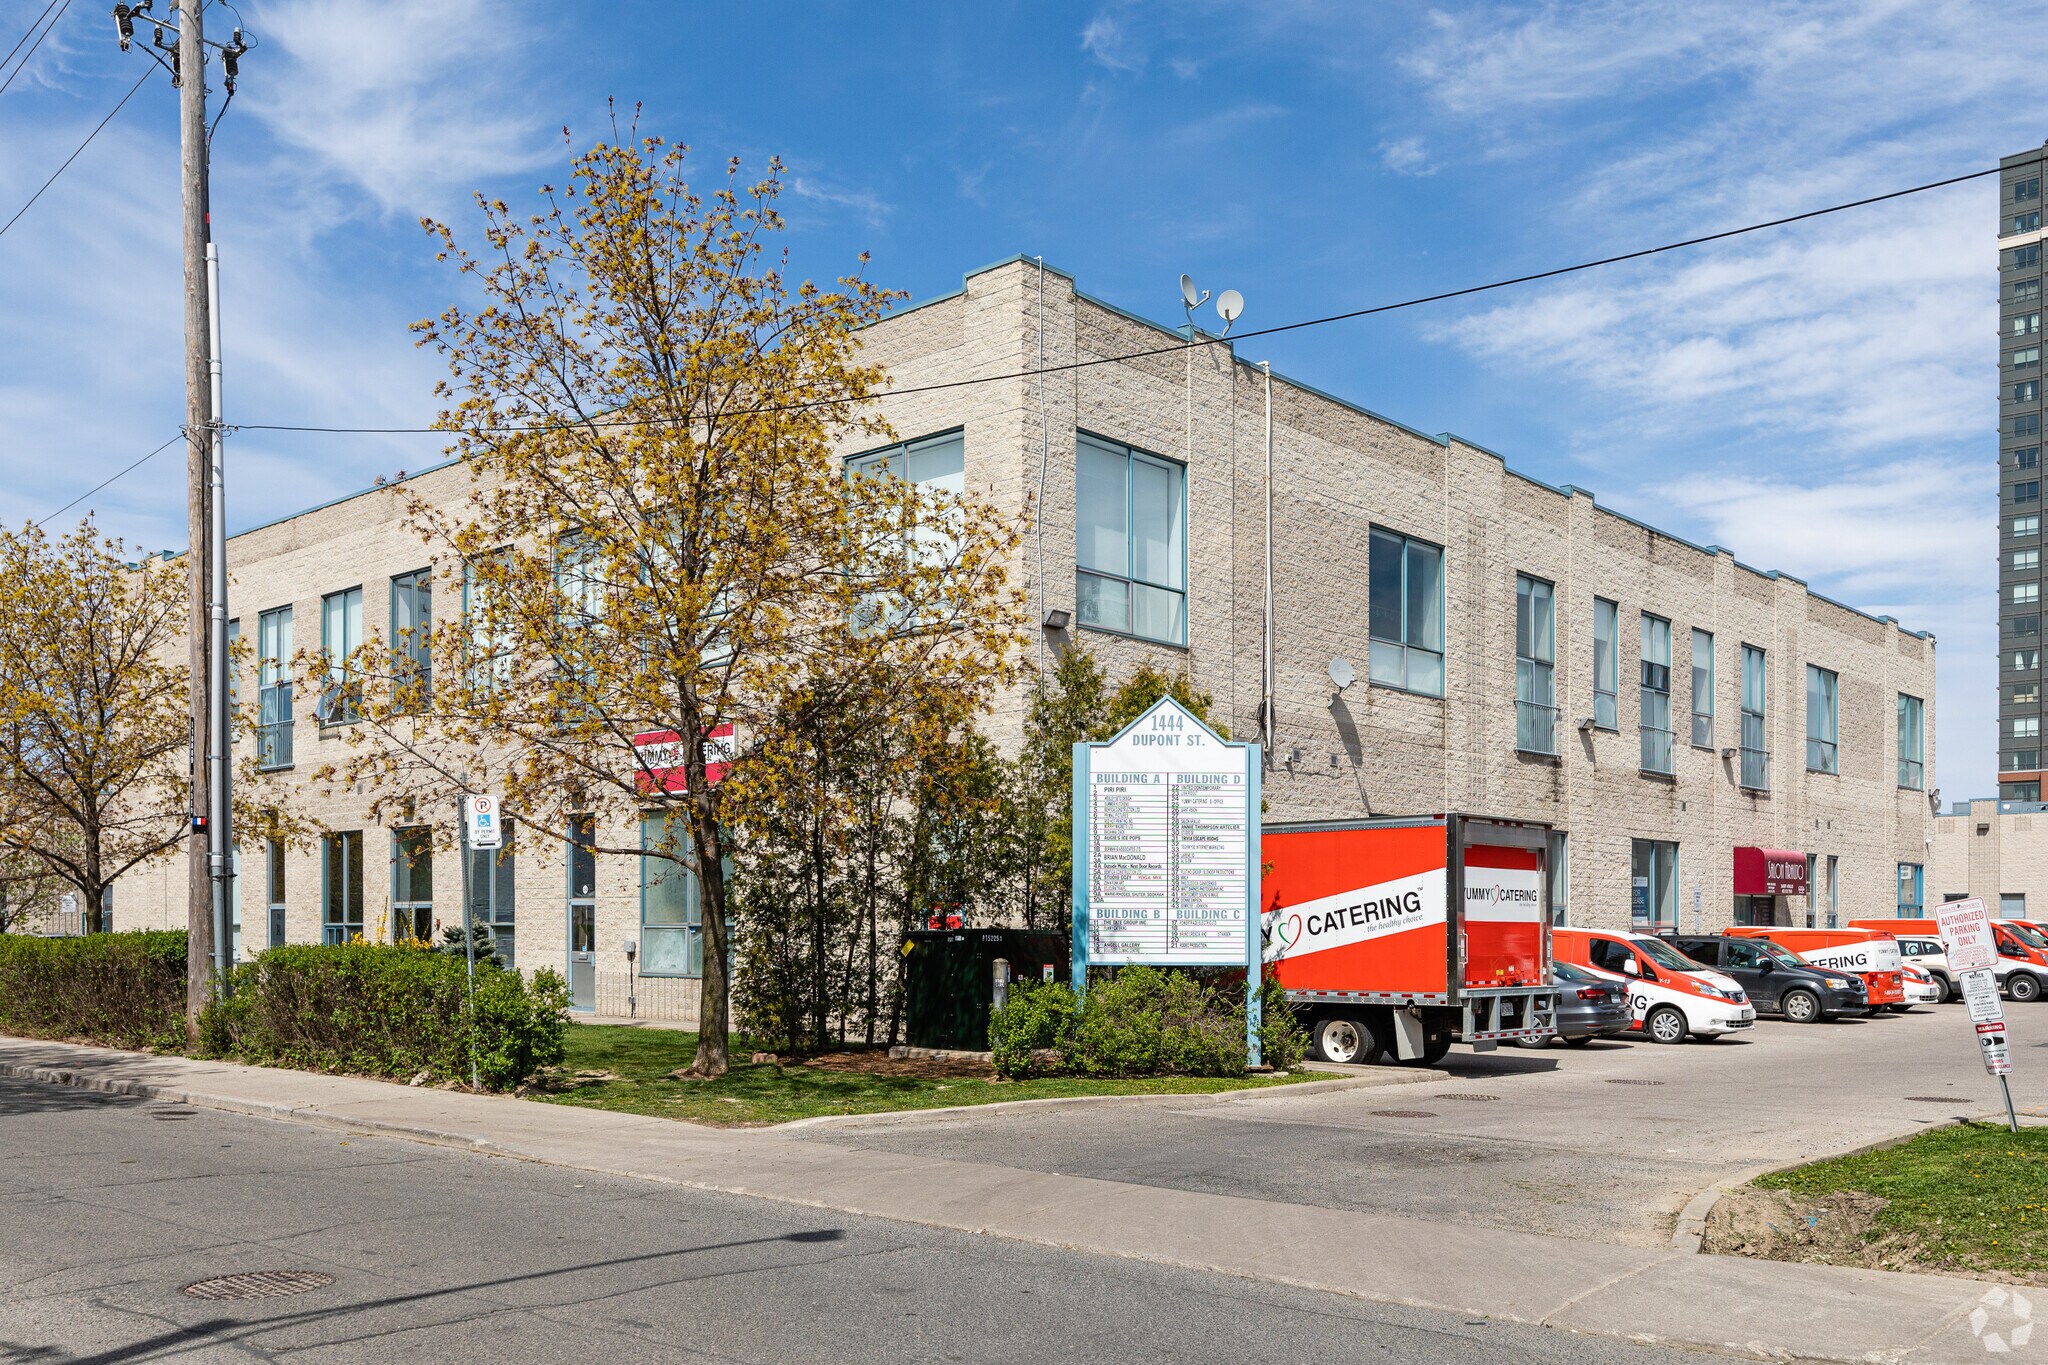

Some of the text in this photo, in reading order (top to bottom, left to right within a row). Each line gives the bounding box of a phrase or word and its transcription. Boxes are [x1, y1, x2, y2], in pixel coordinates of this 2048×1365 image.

[1151, 714, 1184, 732] 1444
[1132, 734, 1206, 747] DUPONT ST.
[1096, 773, 1161, 784] BUILDING A
[1176, 774, 1241, 784] BUILDING D
[1499, 888, 1537, 902] CATERING
[1632, 889, 1641, 897] FOR
[1096, 909, 1161, 919] BUILDING B
[1176, 909, 1240, 920] BUILDING C
[1307, 891, 1421, 936] CATERING
[1941, 910, 1984, 927] AUTHORIZED
[1367, 921, 1378, 933] the
[1378, 916, 1402, 931] healthy
[1949, 922, 1981, 937] PARKING
[1957, 934, 1977, 947] ONLY
[1810, 953, 1867, 969] TERING
